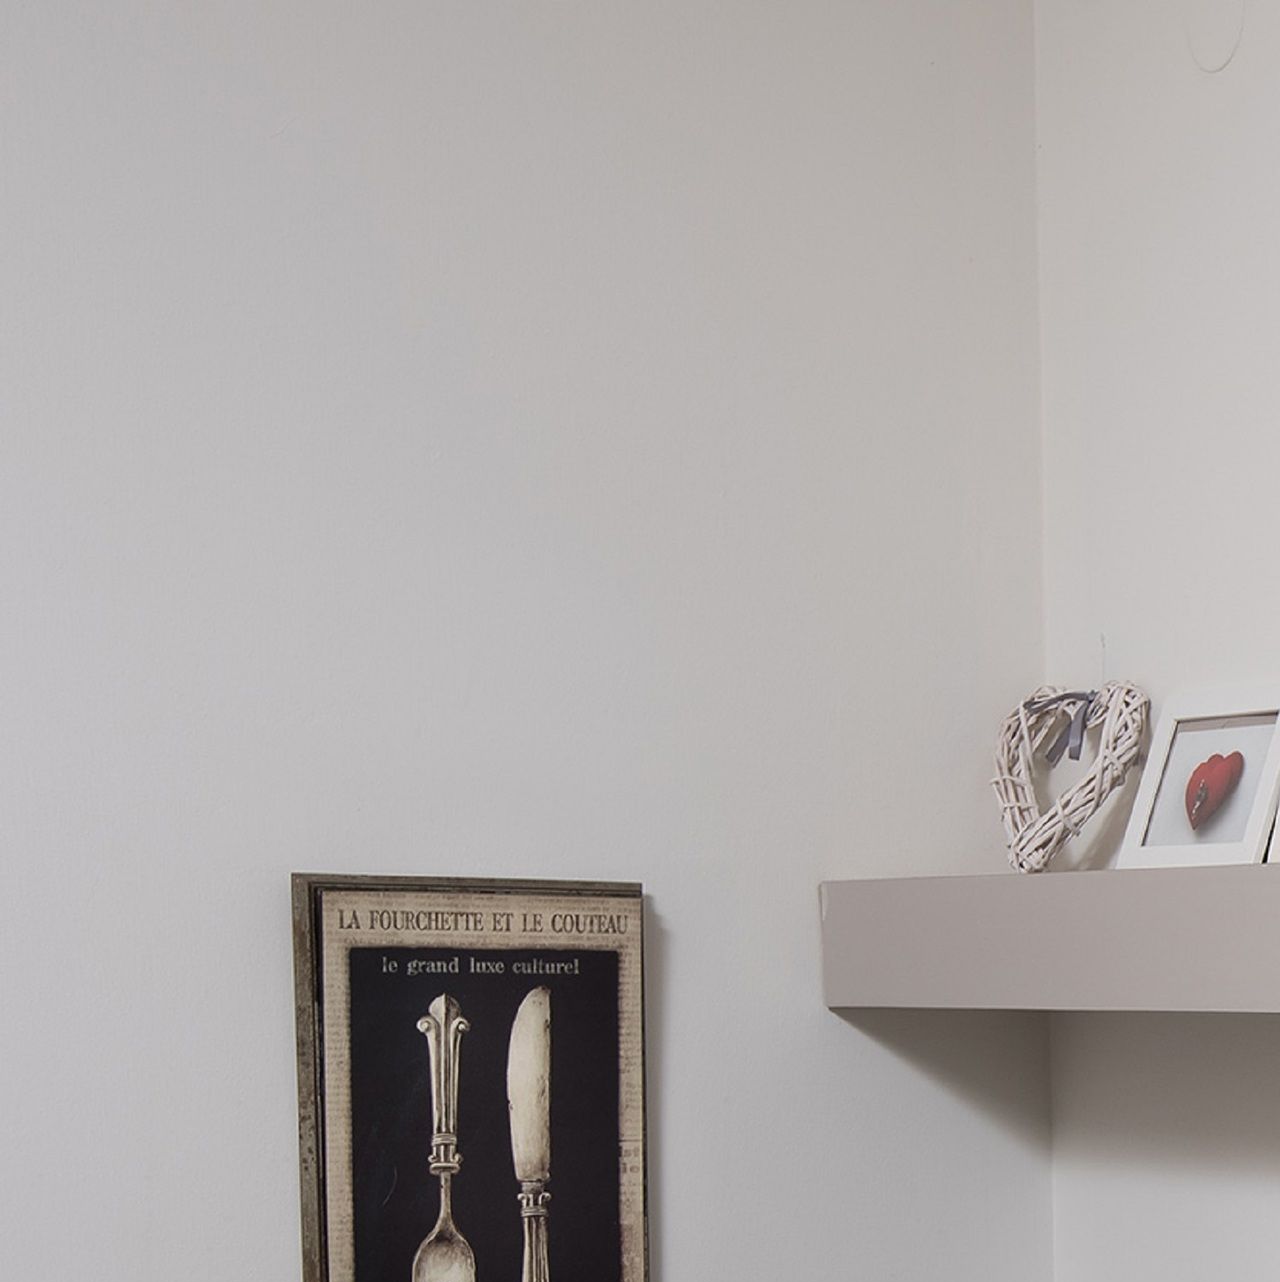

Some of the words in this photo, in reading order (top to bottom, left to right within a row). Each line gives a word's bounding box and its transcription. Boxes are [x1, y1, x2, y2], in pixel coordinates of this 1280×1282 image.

[338, 910, 361, 931] LA
[369, 910, 484, 932] FOURCHETTE
[492, 912, 514, 932] ET
[522, 913, 543, 933] LE
[551, 913, 629, 934] COUTEAU
[382, 957, 398, 972] le
[407, 956, 459, 976] grand
[470, 957, 505, 973] luxe
[512, 958, 580, 975] culturel
